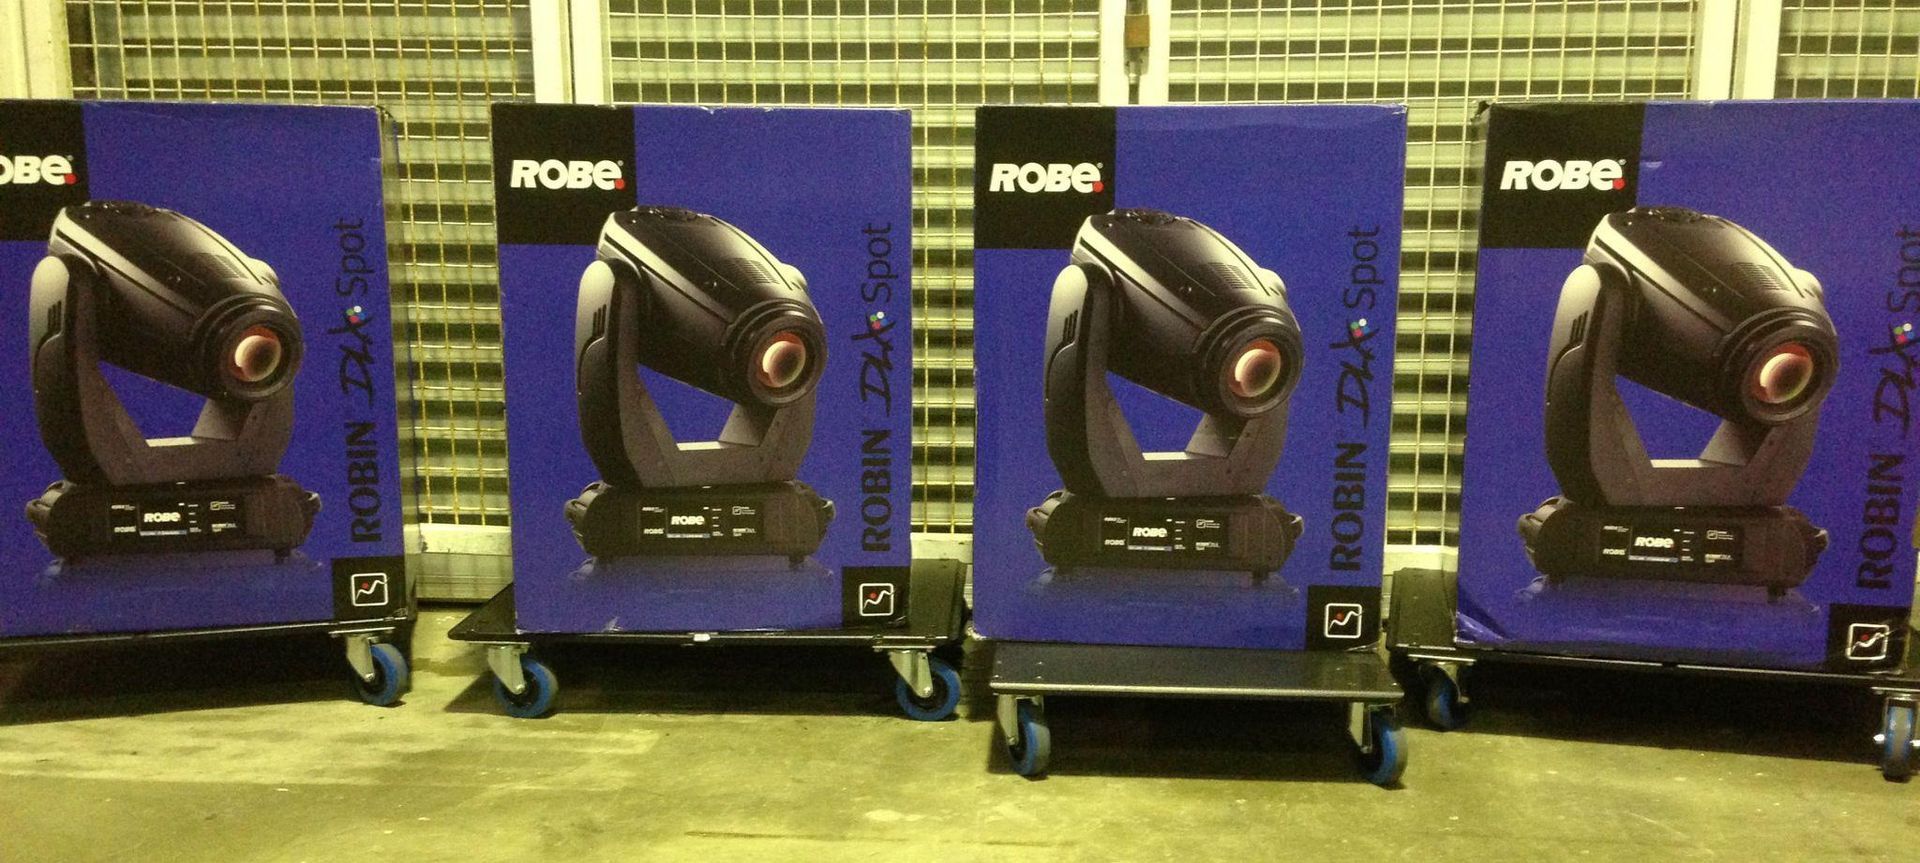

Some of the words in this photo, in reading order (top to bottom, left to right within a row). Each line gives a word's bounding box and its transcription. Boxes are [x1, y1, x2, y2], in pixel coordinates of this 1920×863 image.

[334, 217, 375, 297] Spot
[860, 222, 899, 302] Spot
[1343, 224, 1385, 310] Spot
[345, 421, 382, 543] ROBIN
[860, 429, 892, 552] ROBIN
[1330, 443, 1368, 571] ROBIN
[1856, 453, 1905, 590] ROBIN
